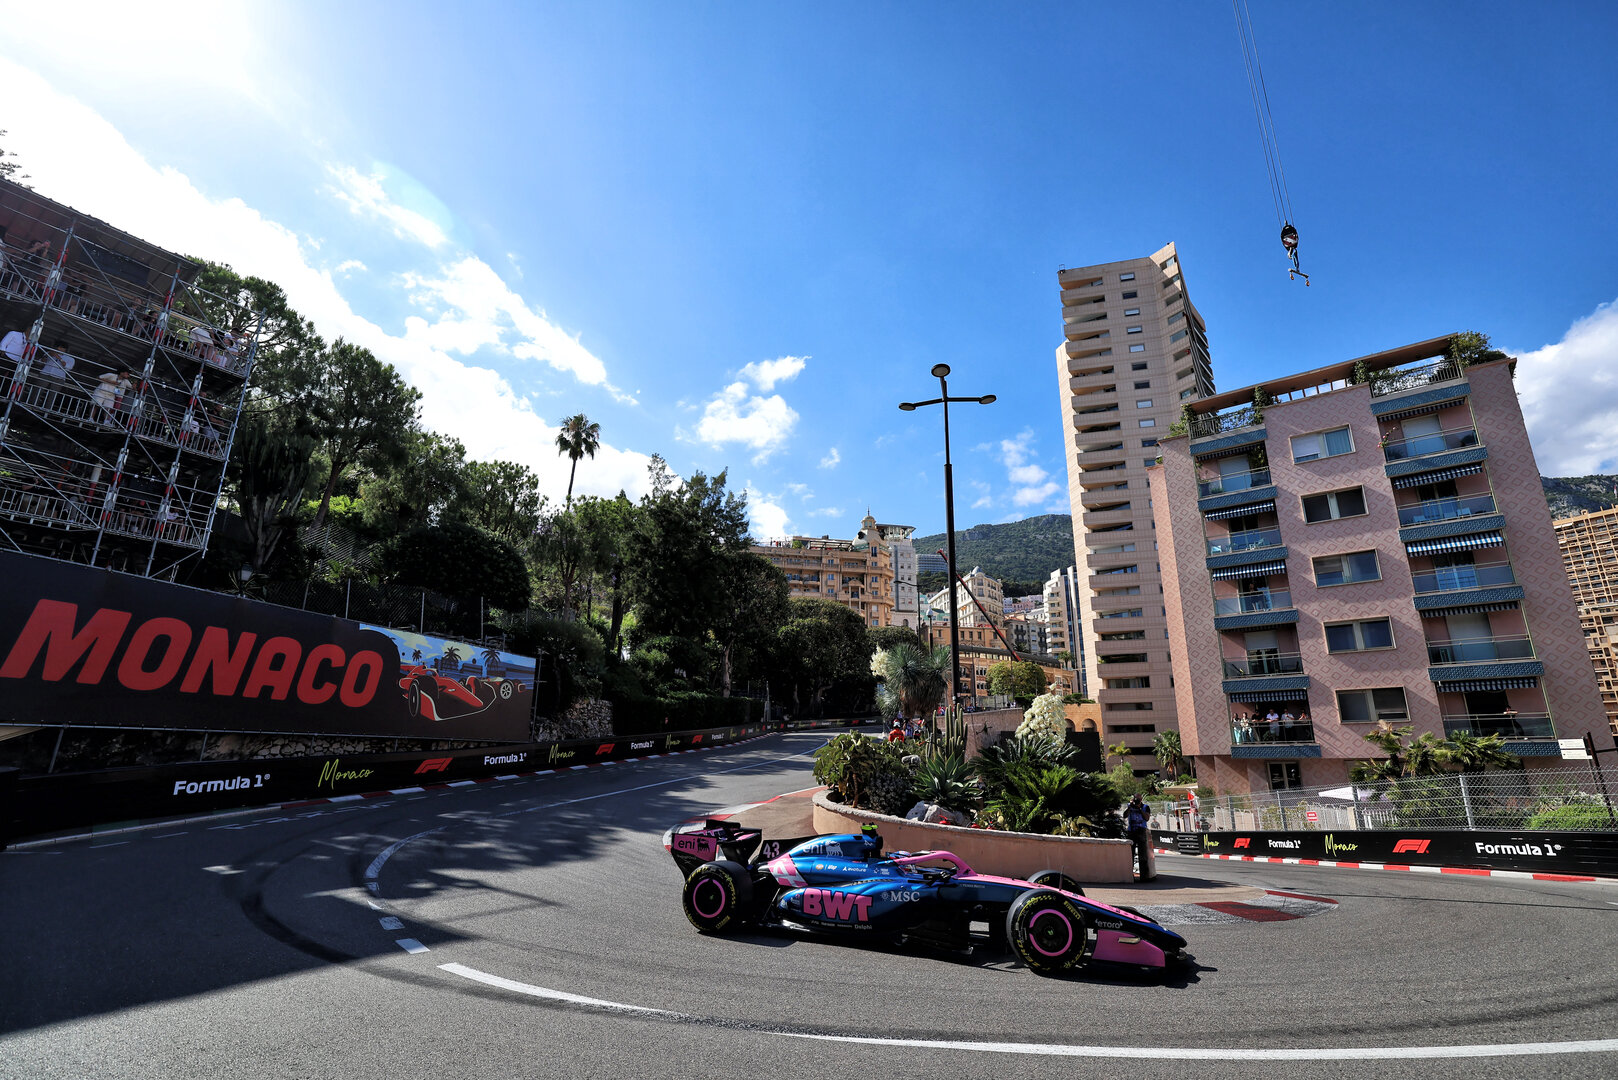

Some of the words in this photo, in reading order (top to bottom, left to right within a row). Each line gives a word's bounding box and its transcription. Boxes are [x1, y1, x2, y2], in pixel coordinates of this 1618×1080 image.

[0, 599, 384, 707] MONACO
[484, 754, 518, 765] Formula
[548, 743, 576, 765] Monaco
[317, 758, 374, 790] Monaco
[173, 776, 250, 795] Formula
[677, 839, 695, 849] eni
[763, 841, 780, 859] 43
[802, 841, 824, 854] eni
[1268, 840, 1294, 848] Formula
[1324, 833, 1358, 857] Monaco
[1475, 842, 1542, 856] Formula
[803, 888, 873, 922] BWT
[890, 891, 921, 902] MSC
